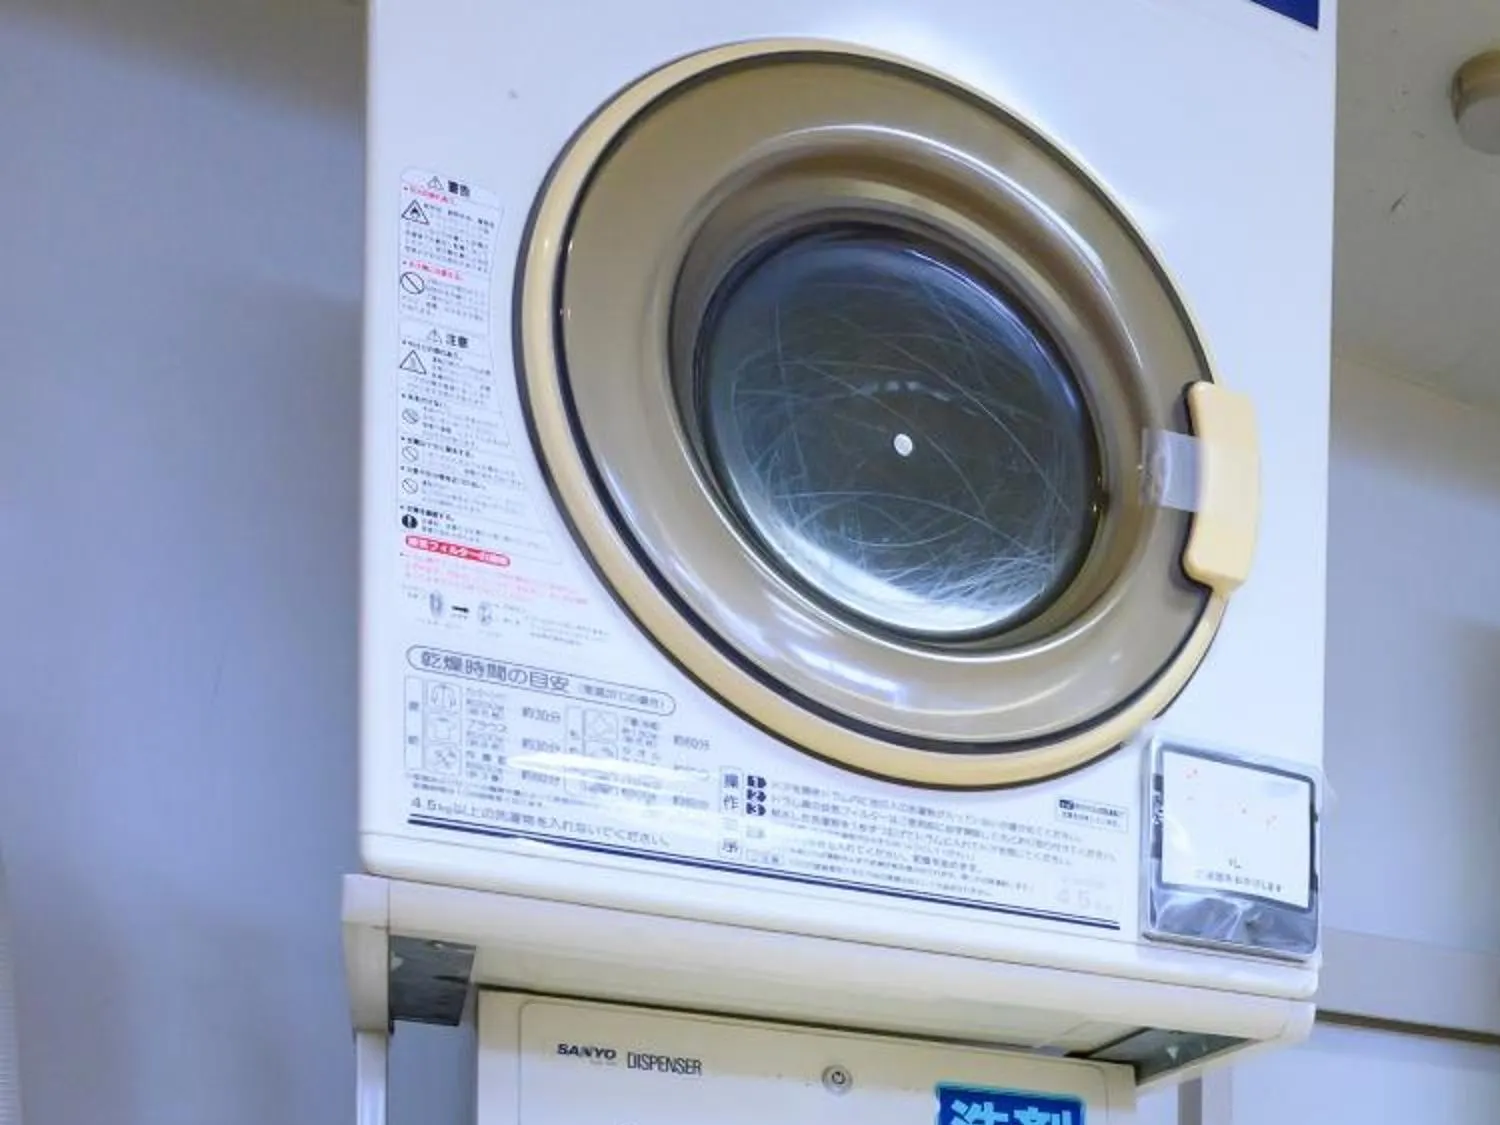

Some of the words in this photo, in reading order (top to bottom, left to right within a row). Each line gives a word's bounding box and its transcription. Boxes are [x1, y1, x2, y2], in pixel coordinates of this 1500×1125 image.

[420, 650, 570, 692] 乾燥時間の目安
[557, 1042, 617, 1061] SANYO
[627, 1051, 702, 1076] DISPENSER
